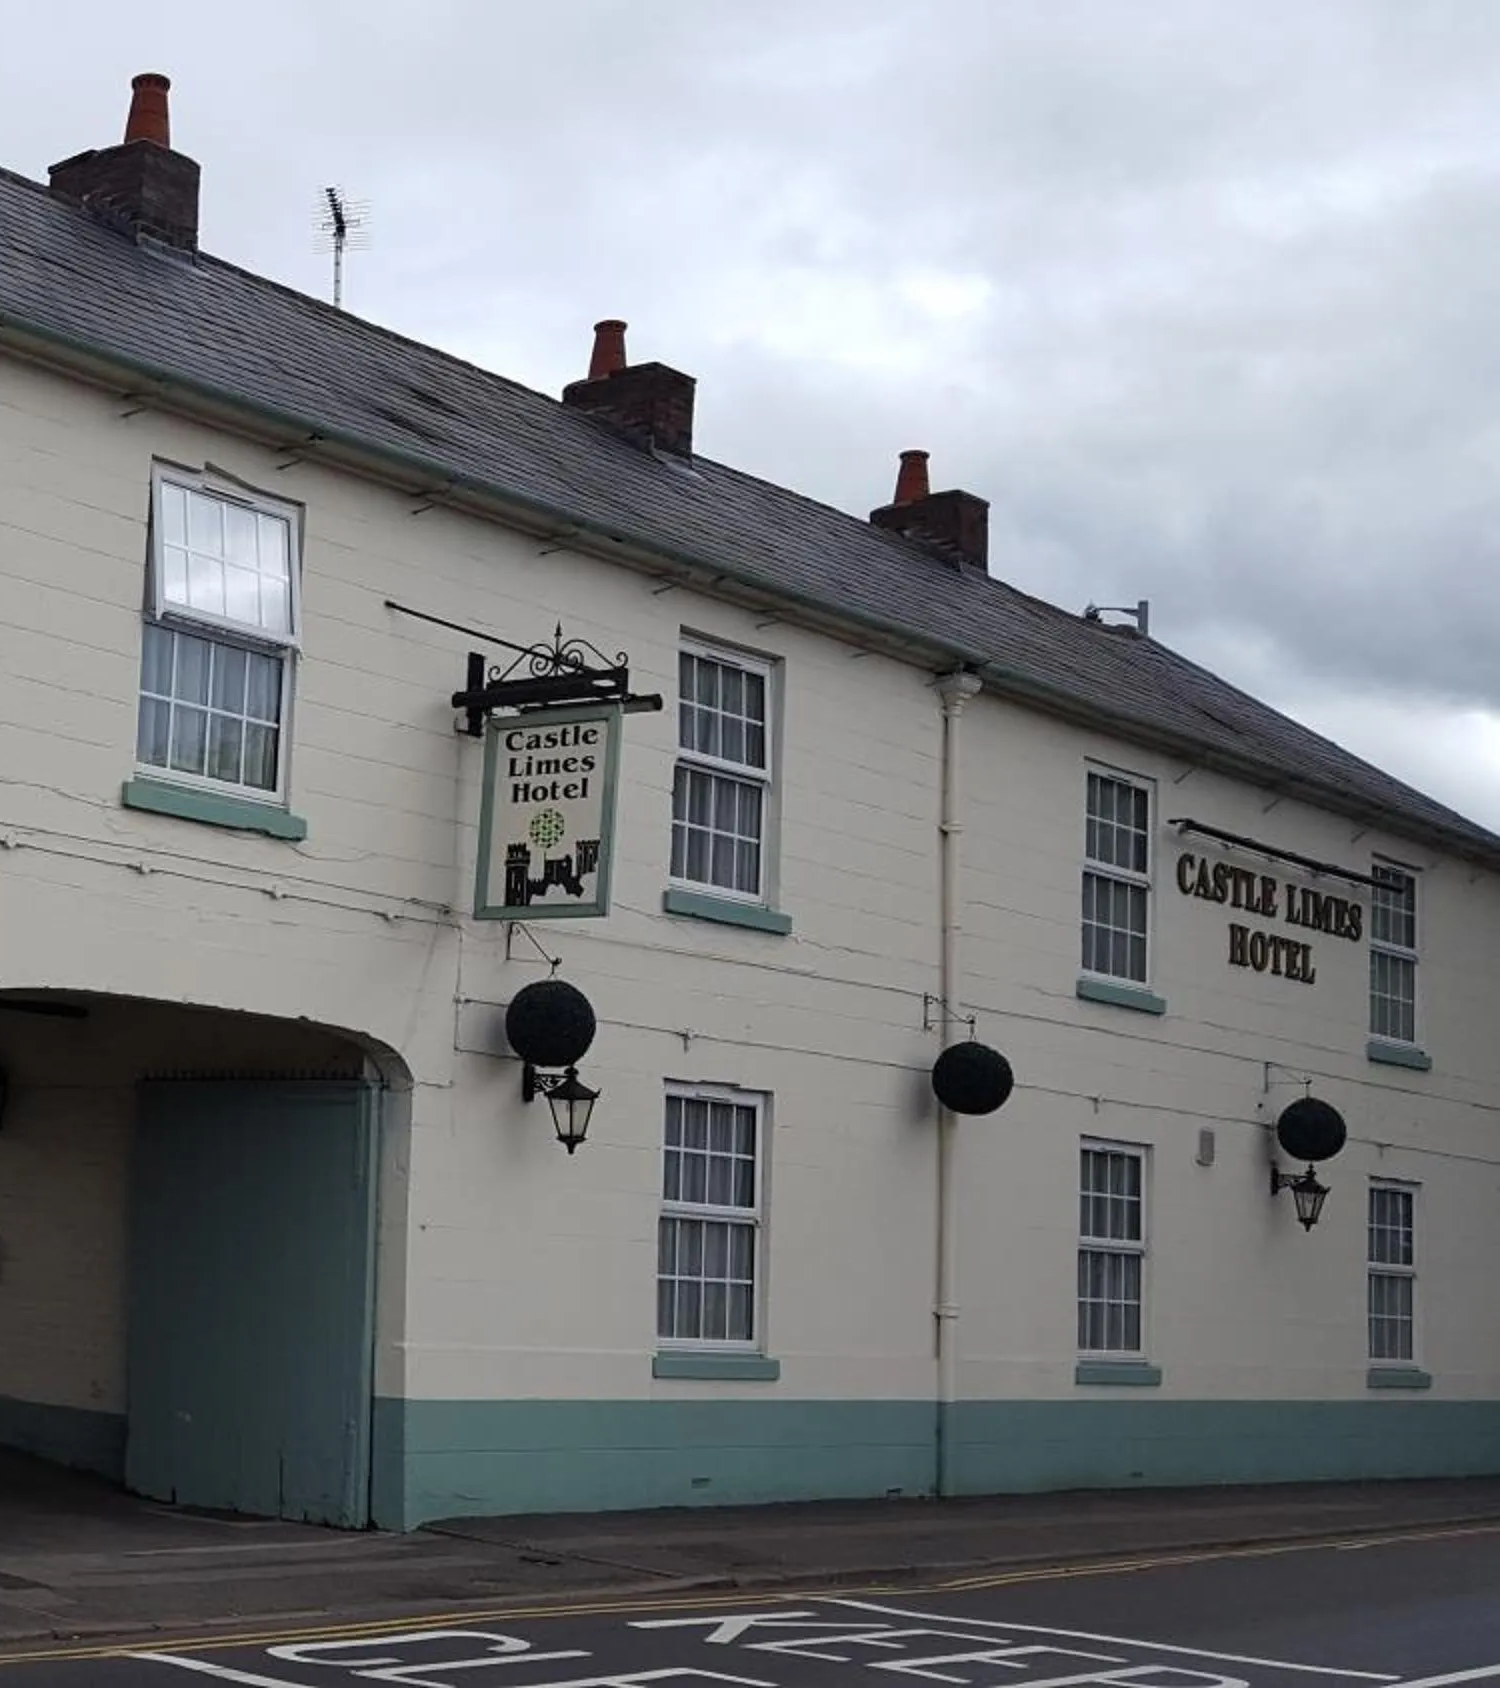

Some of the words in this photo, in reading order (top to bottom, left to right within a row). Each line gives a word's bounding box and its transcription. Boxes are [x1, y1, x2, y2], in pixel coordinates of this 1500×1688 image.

[505, 725, 598, 751] Castle
[509, 755, 595, 777] Limes
[512, 777, 588, 803] Hotel
[1177, 853, 1277, 917] CASTLE
[1285, 884, 1362, 941] LIMES
[1228, 923, 1315, 984] HOTEL
[626, 1611, 1250, 1688] KEEP
